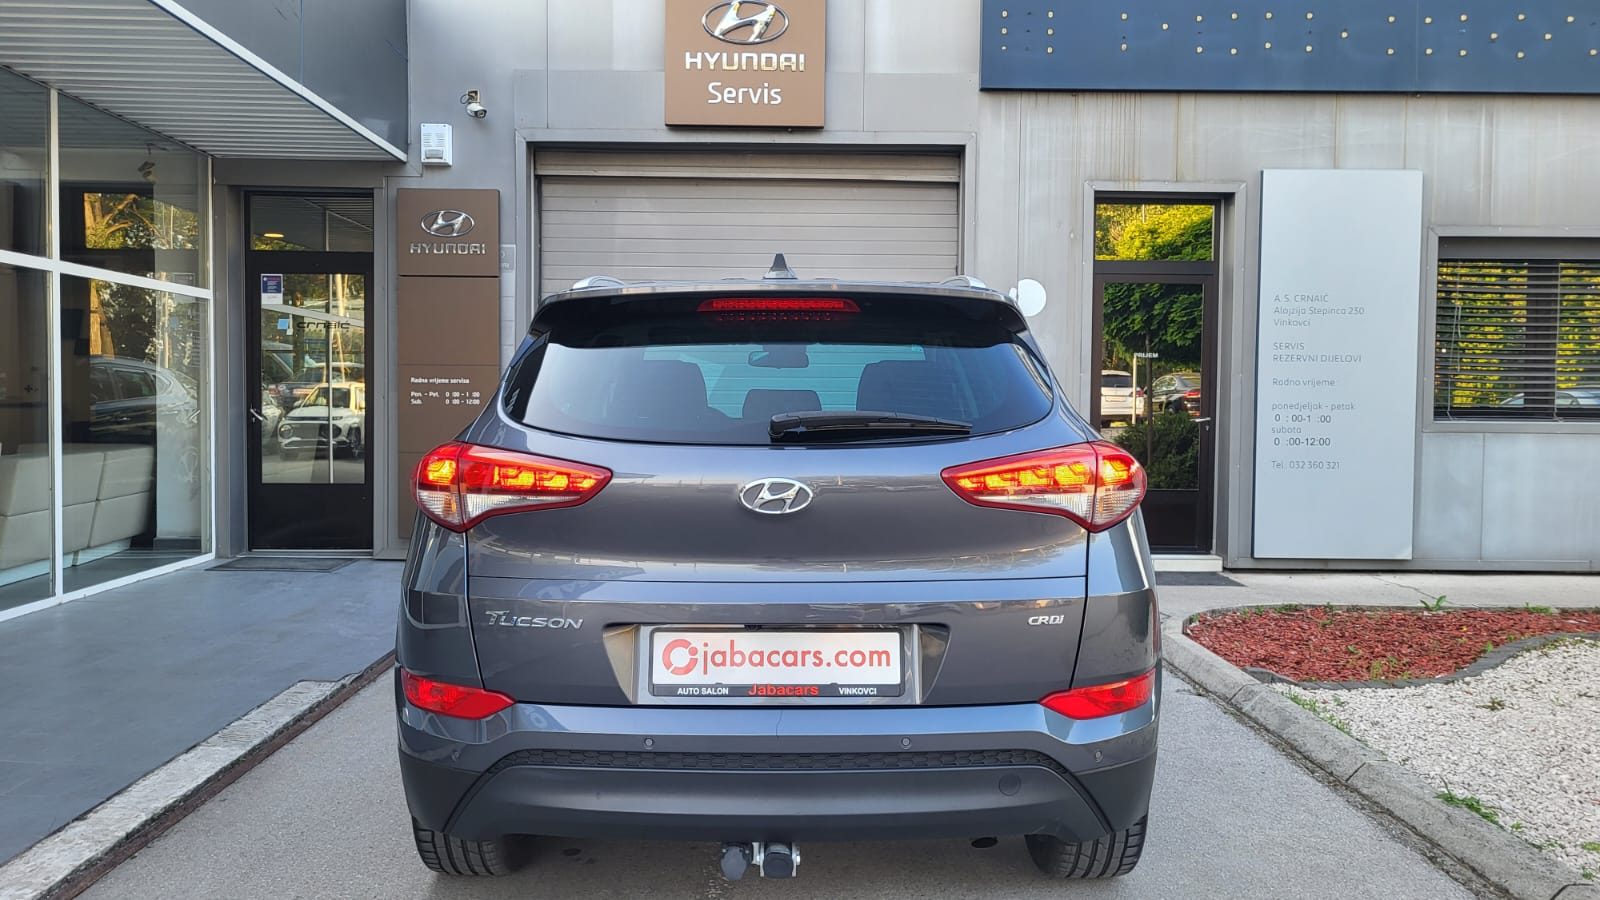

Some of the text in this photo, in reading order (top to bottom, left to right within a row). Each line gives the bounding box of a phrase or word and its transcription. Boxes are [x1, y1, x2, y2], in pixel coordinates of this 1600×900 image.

[685, 51, 806, 72] HYUNDAI
[707, 82, 783, 105] Servis
[410, 243, 486, 255] HYUNDAI
[1309, 306, 1346, 316] Stepinca
[1273, 318, 1311, 327] Vinkovci
[1272, 342, 1305, 351] SERVIS
[1272, 354, 1318, 363] REZERVNI
[1272, 378, 1336, 388] Radno vrijeme
[1271, 402, 1322, 412] ponedjeljak
[1331, 402, 1355, 411] petak
[1271, 426, 1302, 435] subota
[1289, 461, 1306, 470] 032
[1308, 461, 1325, 470] 360
[702, 639, 891, 675] jabacars.com
[677, 684, 877, 696] AUTO SALON Jabacars VINKOVCI
